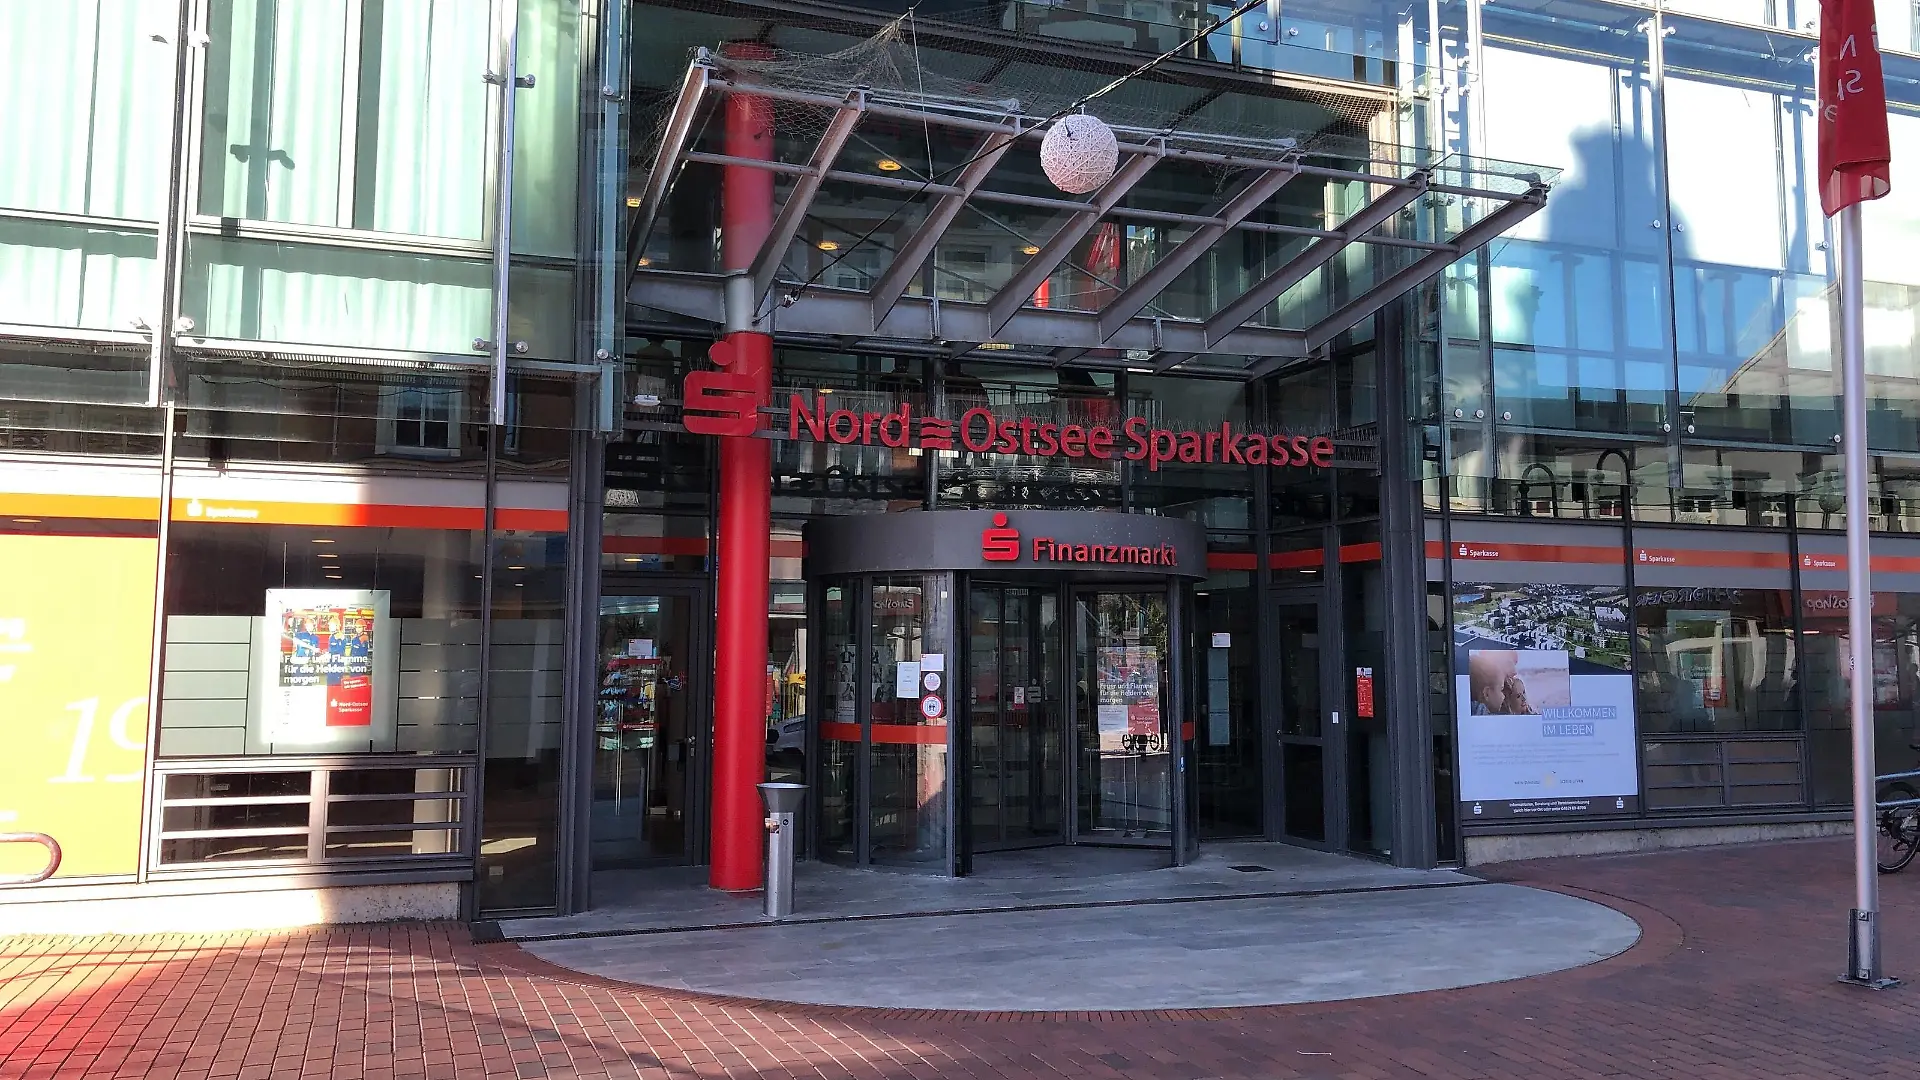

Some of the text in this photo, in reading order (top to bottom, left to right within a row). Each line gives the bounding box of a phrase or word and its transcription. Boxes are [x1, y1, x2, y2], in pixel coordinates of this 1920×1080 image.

[789, 394, 1335, 472] Nord Ostsee Sparkasse
[1033, 536, 1178, 566] Finanzmarkt
[1469, 549, 1499, 558] Sparkasse
[1648, 555, 1676, 563] Sparkasse
[284, 676, 319, 685] morgen
[1542, 707, 1616, 719] WILLKOMMEN
[1543, 724, 1594, 735] IM LEBEN
